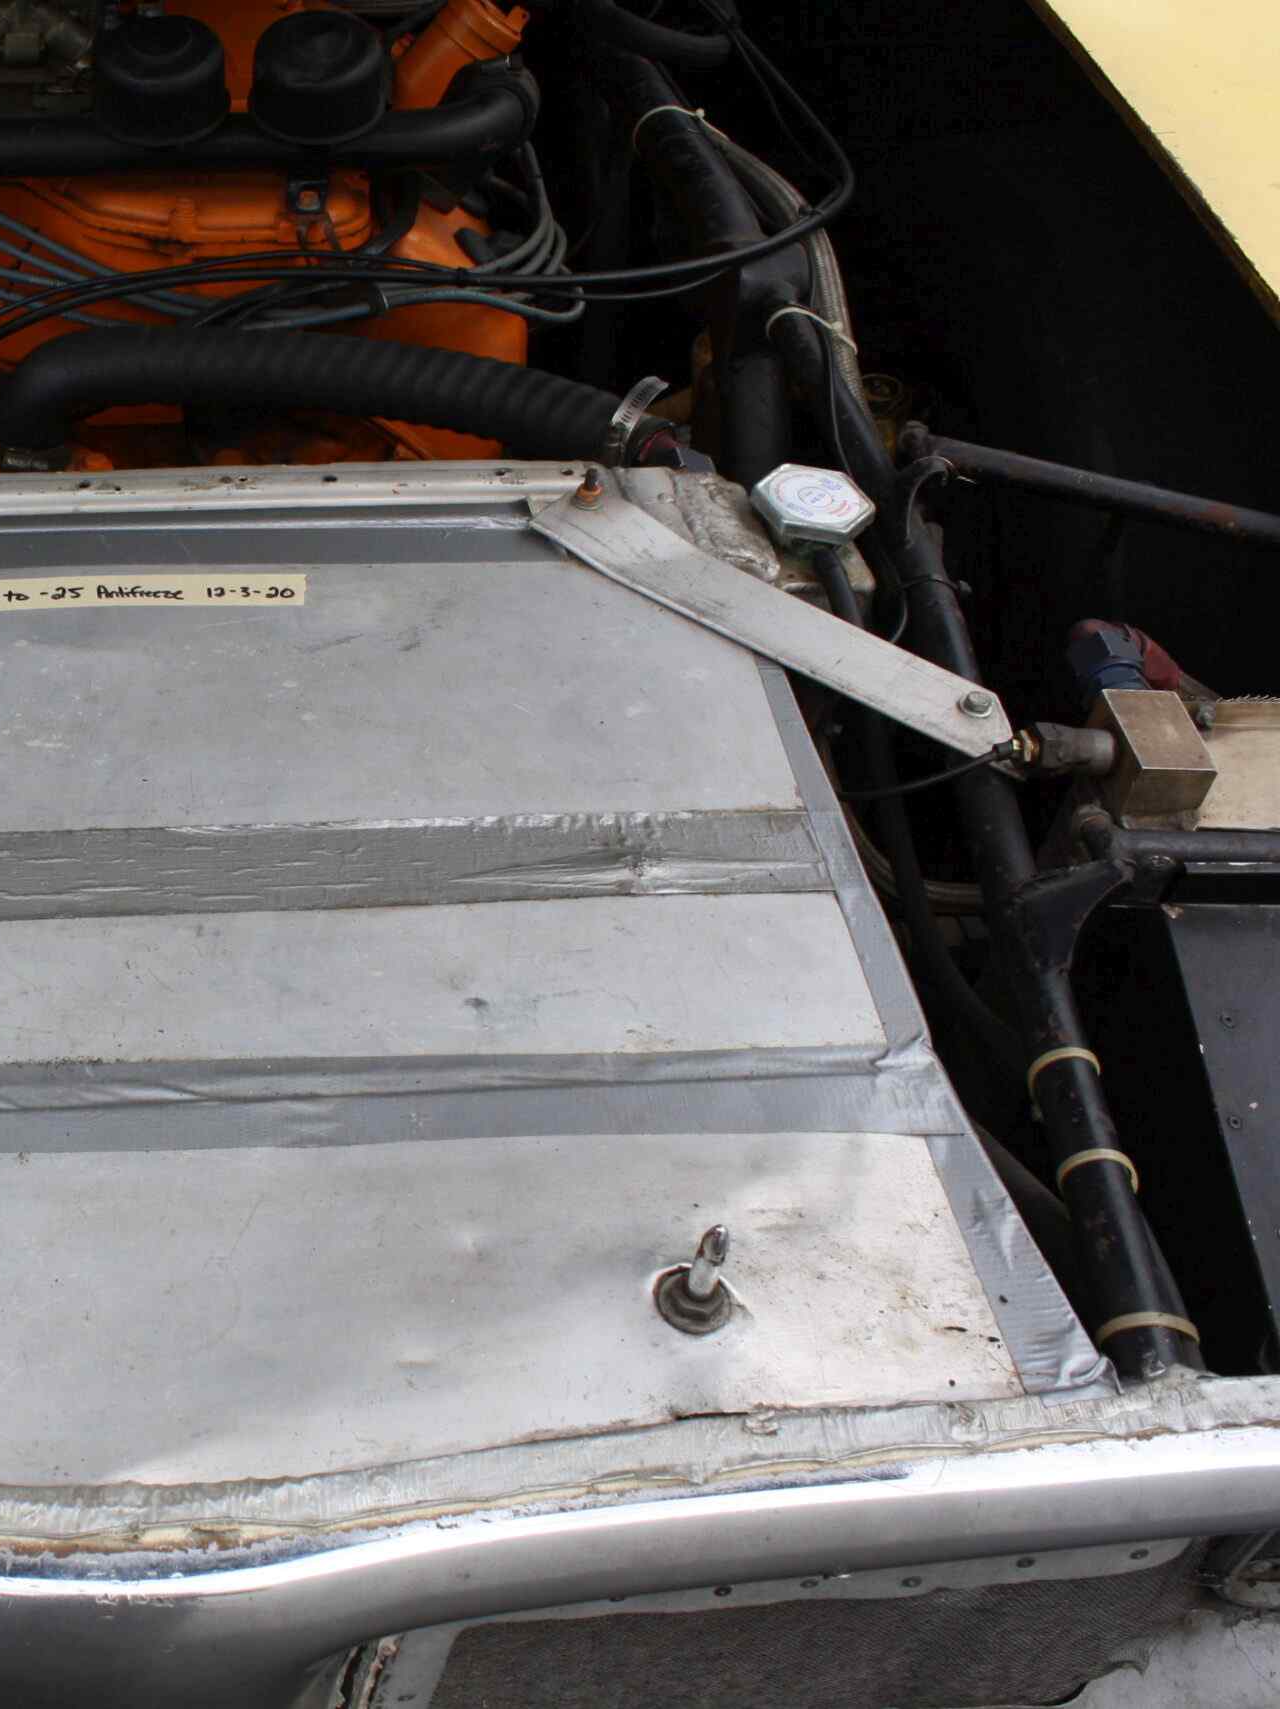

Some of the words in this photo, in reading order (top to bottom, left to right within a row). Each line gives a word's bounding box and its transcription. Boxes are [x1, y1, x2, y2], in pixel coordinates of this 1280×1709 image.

[2, 590, 30, 602] to
[39, 586, 84, 600] -25
[96, 584, 185, 600] Antifreeze
[206, 586, 296, 599] 12-3-20
